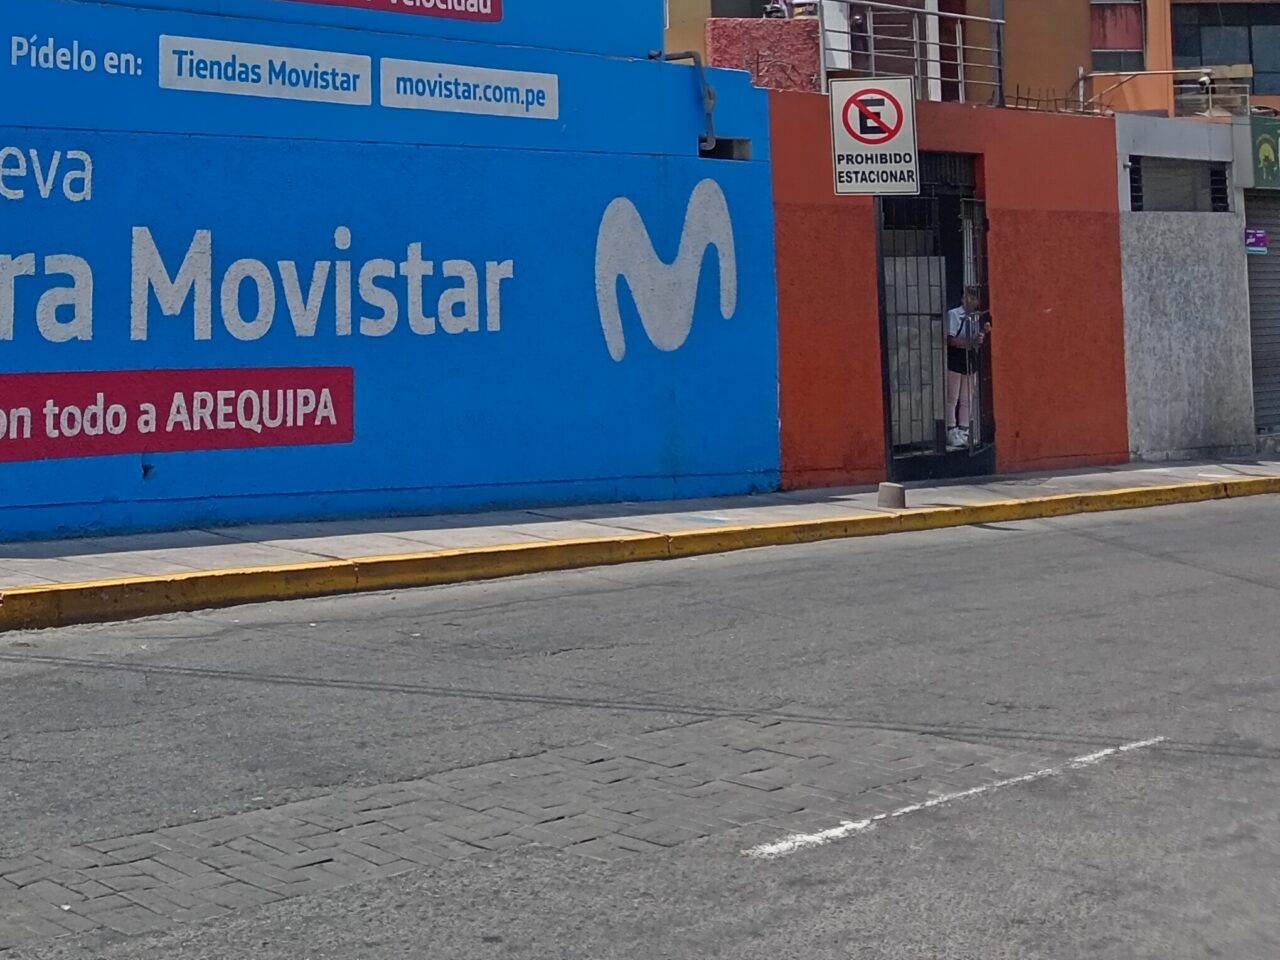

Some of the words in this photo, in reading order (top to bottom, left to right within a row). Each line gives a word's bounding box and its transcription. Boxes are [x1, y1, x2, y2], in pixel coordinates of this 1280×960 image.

[10, 34, 96, 72] Pídelo
[104, 51, 142, 76] en:
[172, 49, 261, 84] Tiendas
[268, 59, 360, 93] Movistar
[395, 71, 547, 112] movistar.com.pe
[837, 152, 913, 165] PROHIBIDO
[838, 170, 915, 183] ESTACIONAR
[130, 224, 514, 342] Movistar
[44, 392, 128, 437] todo
[136, 402, 160, 434] a
[166, 387, 337, 434] AREQUIPA
